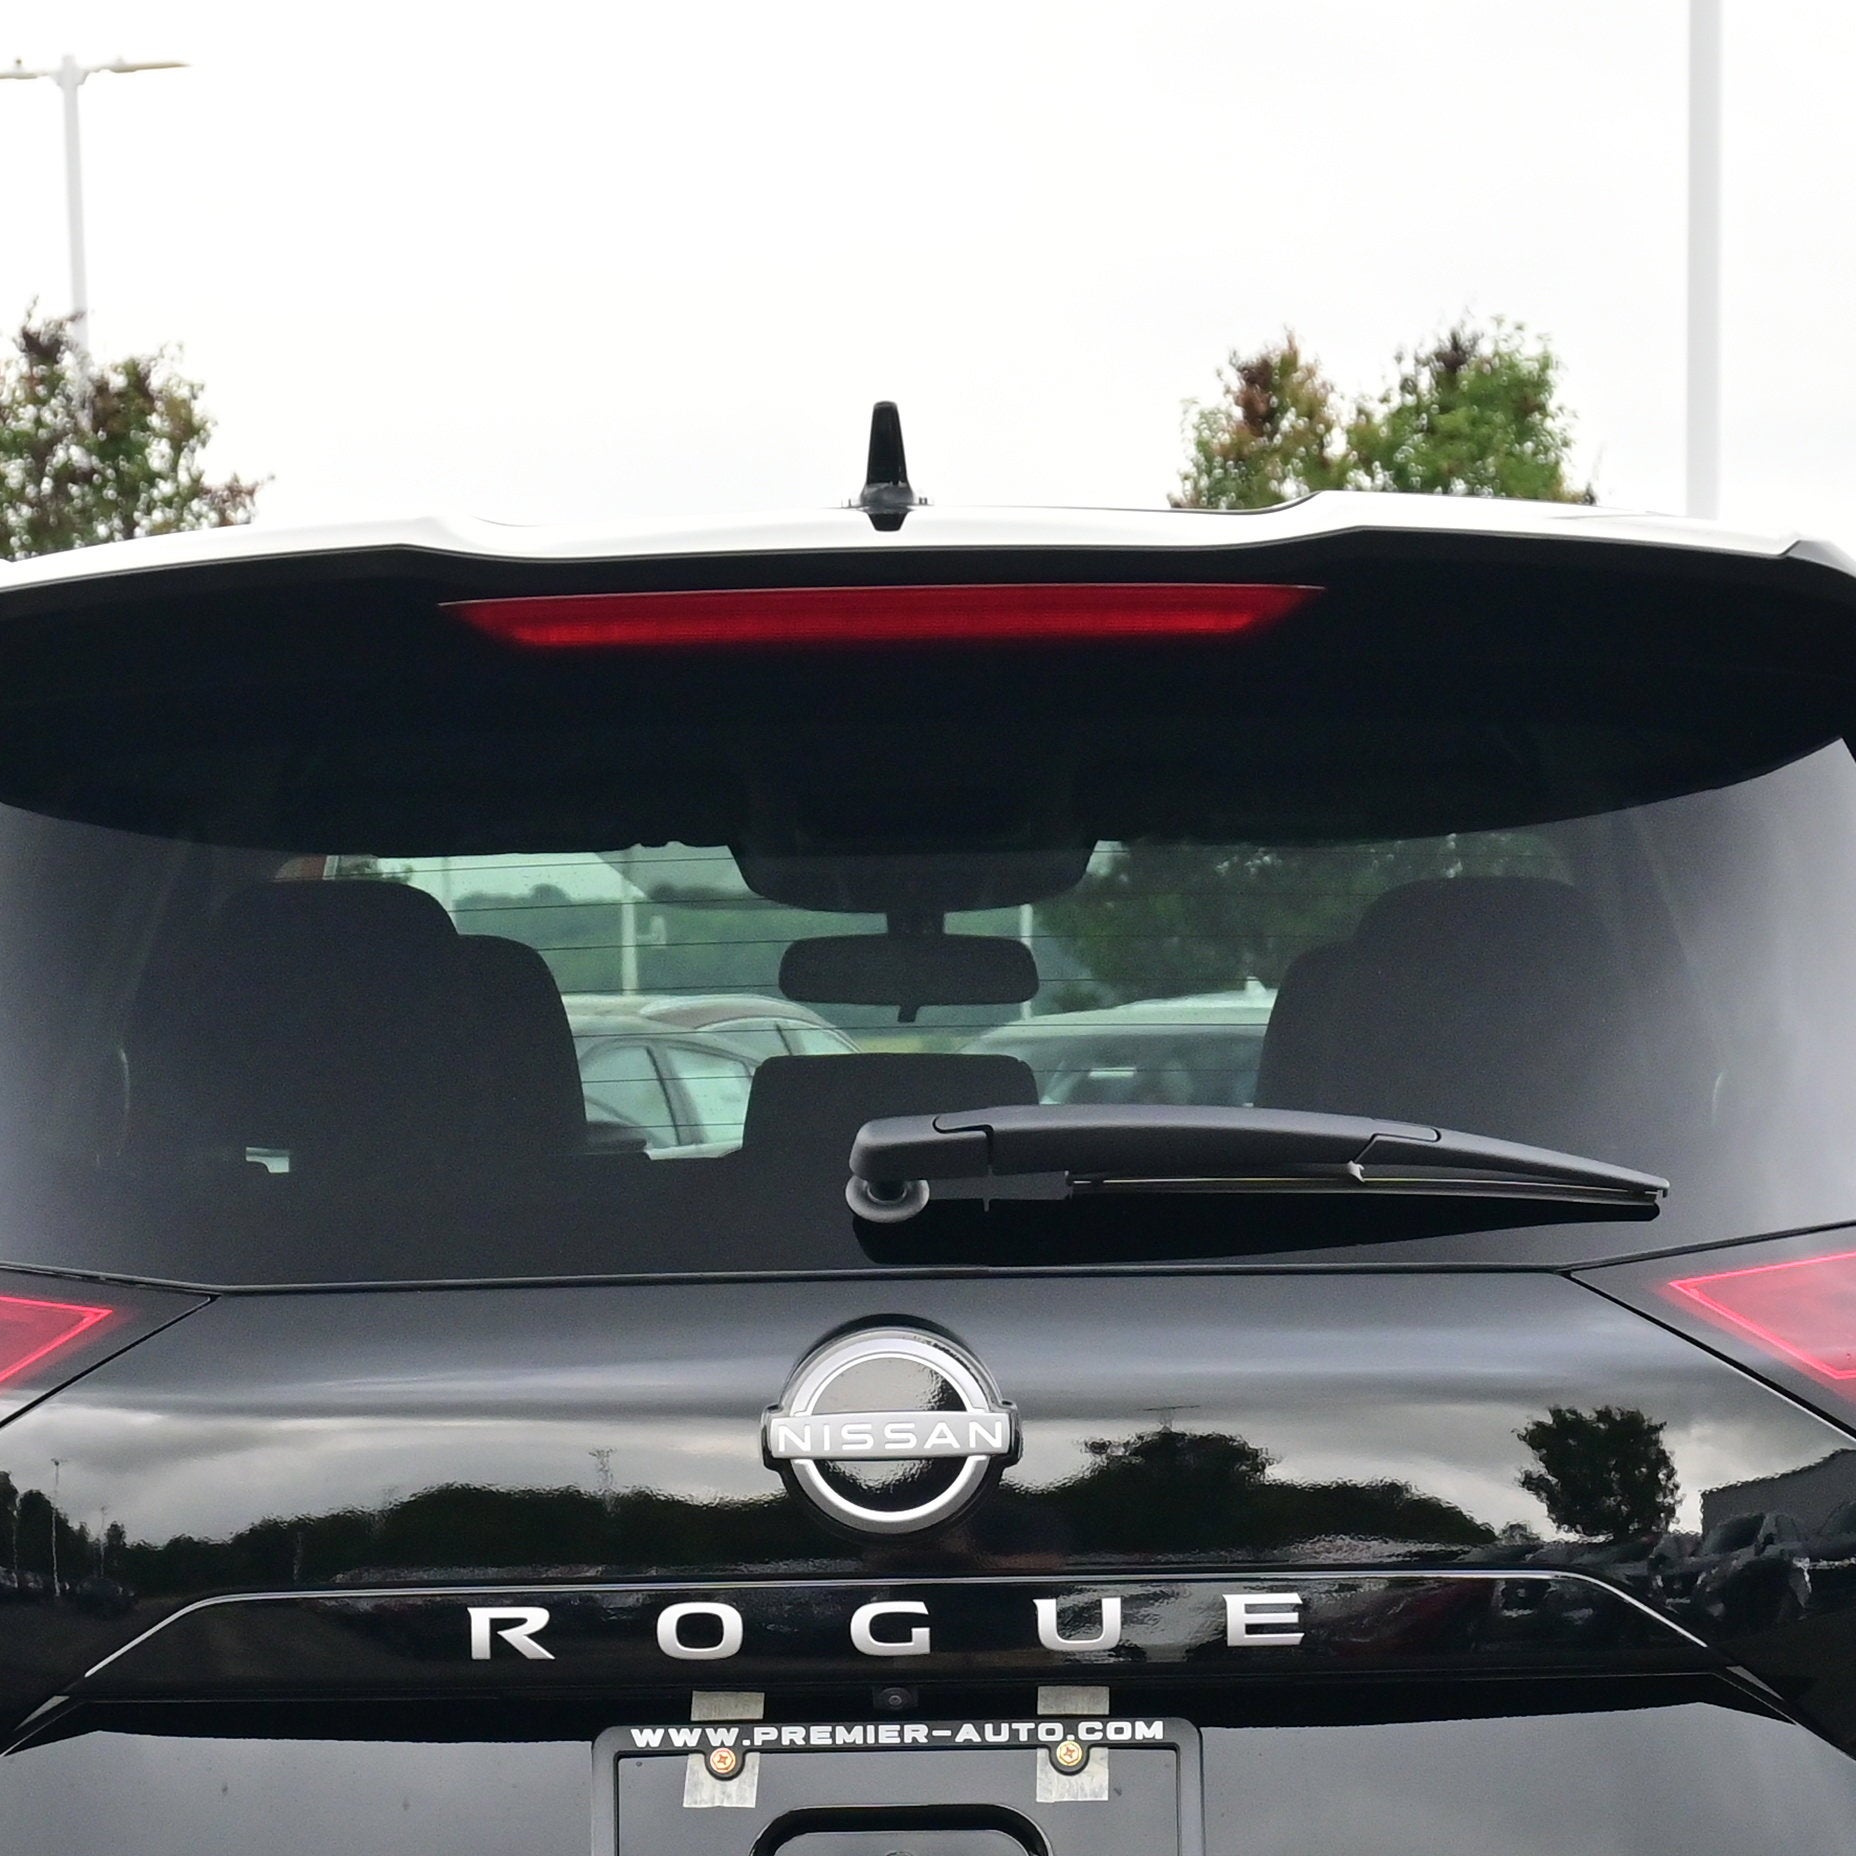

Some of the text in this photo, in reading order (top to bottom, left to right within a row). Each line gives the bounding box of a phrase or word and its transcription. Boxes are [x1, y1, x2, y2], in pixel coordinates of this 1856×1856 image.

[777, 1420, 1003, 1452] NISSAN
[467, 1592, 1305, 1661] ROGUE
[630, 1719, 1165, 1749] WWW.PREMIER-AUTO.COM
